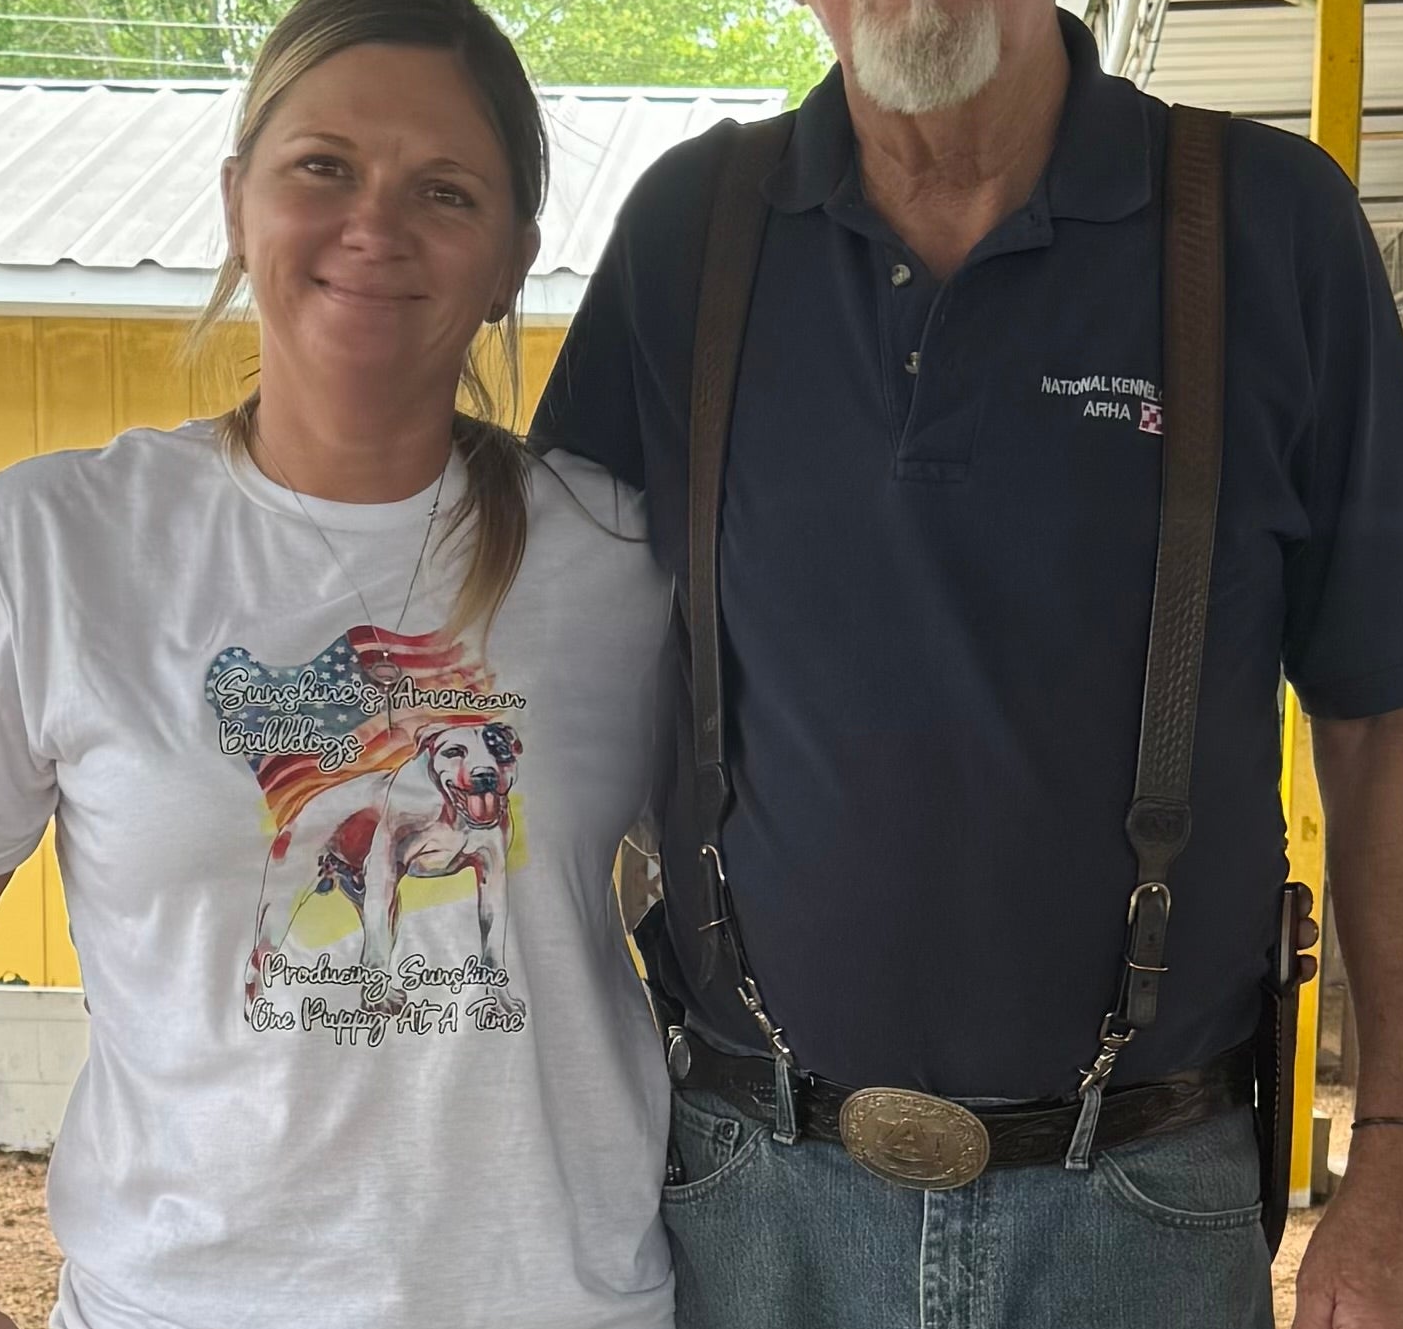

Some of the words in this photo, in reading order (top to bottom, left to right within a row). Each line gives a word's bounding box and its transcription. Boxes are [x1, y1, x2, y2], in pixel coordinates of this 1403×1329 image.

[1041, 375, 1110, 395] NATIONAL
[1083, 400, 1131, 421] ARHA
[213, 667, 384, 713] Sunshine's
[392, 676, 526, 710] American
[218, 716, 365, 773] Bulldogs
[262, 953, 391, 1002] Producing
[398, 953, 509, 994] Sunshine
[250, 997, 295, 1032] One
[301, 997, 391, 1047] Puppy
[438, 1002, 458, 1033] A
[466, 997, 526, 1033] Time
